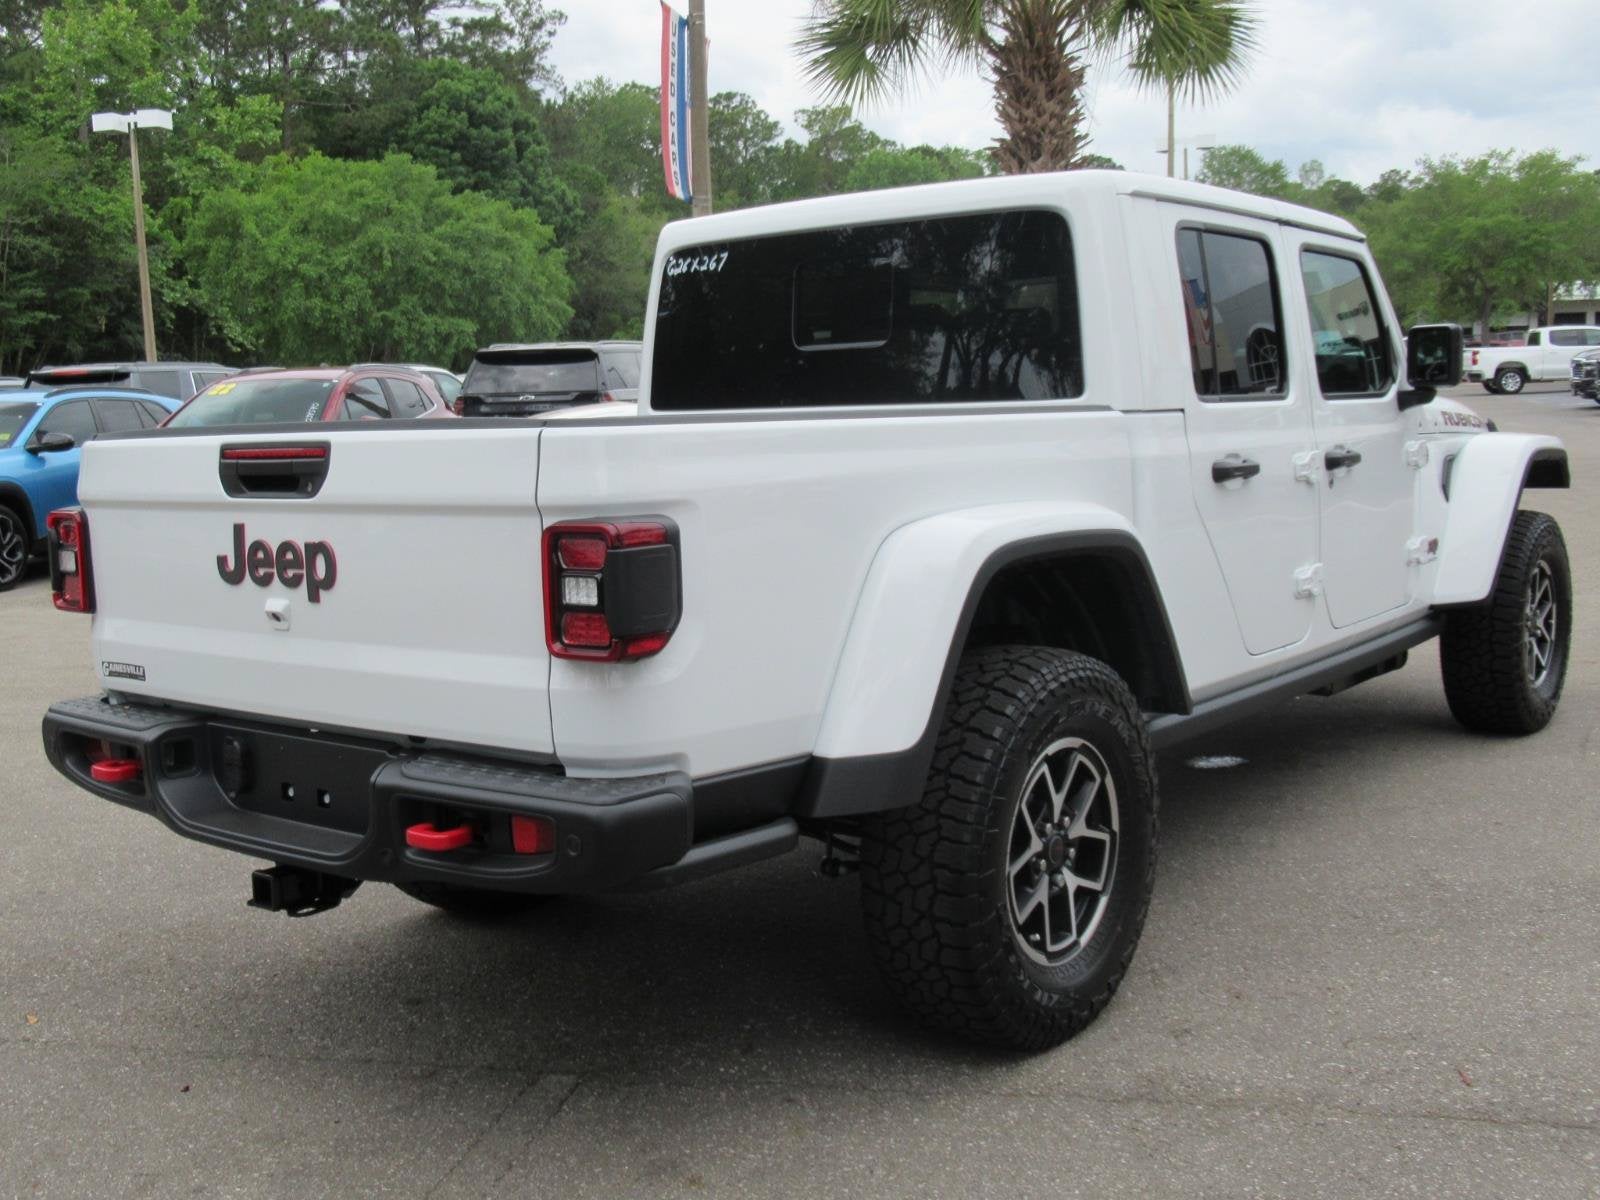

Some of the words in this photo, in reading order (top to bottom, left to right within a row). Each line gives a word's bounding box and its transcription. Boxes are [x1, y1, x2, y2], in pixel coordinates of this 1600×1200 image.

[670, 115, 680, 187] CARS
[1441, 410, 1481, 428] RUBICO
[216, 522, 338, 604] Jeep
[103, 662, 144, 676] GAINESVILLE
